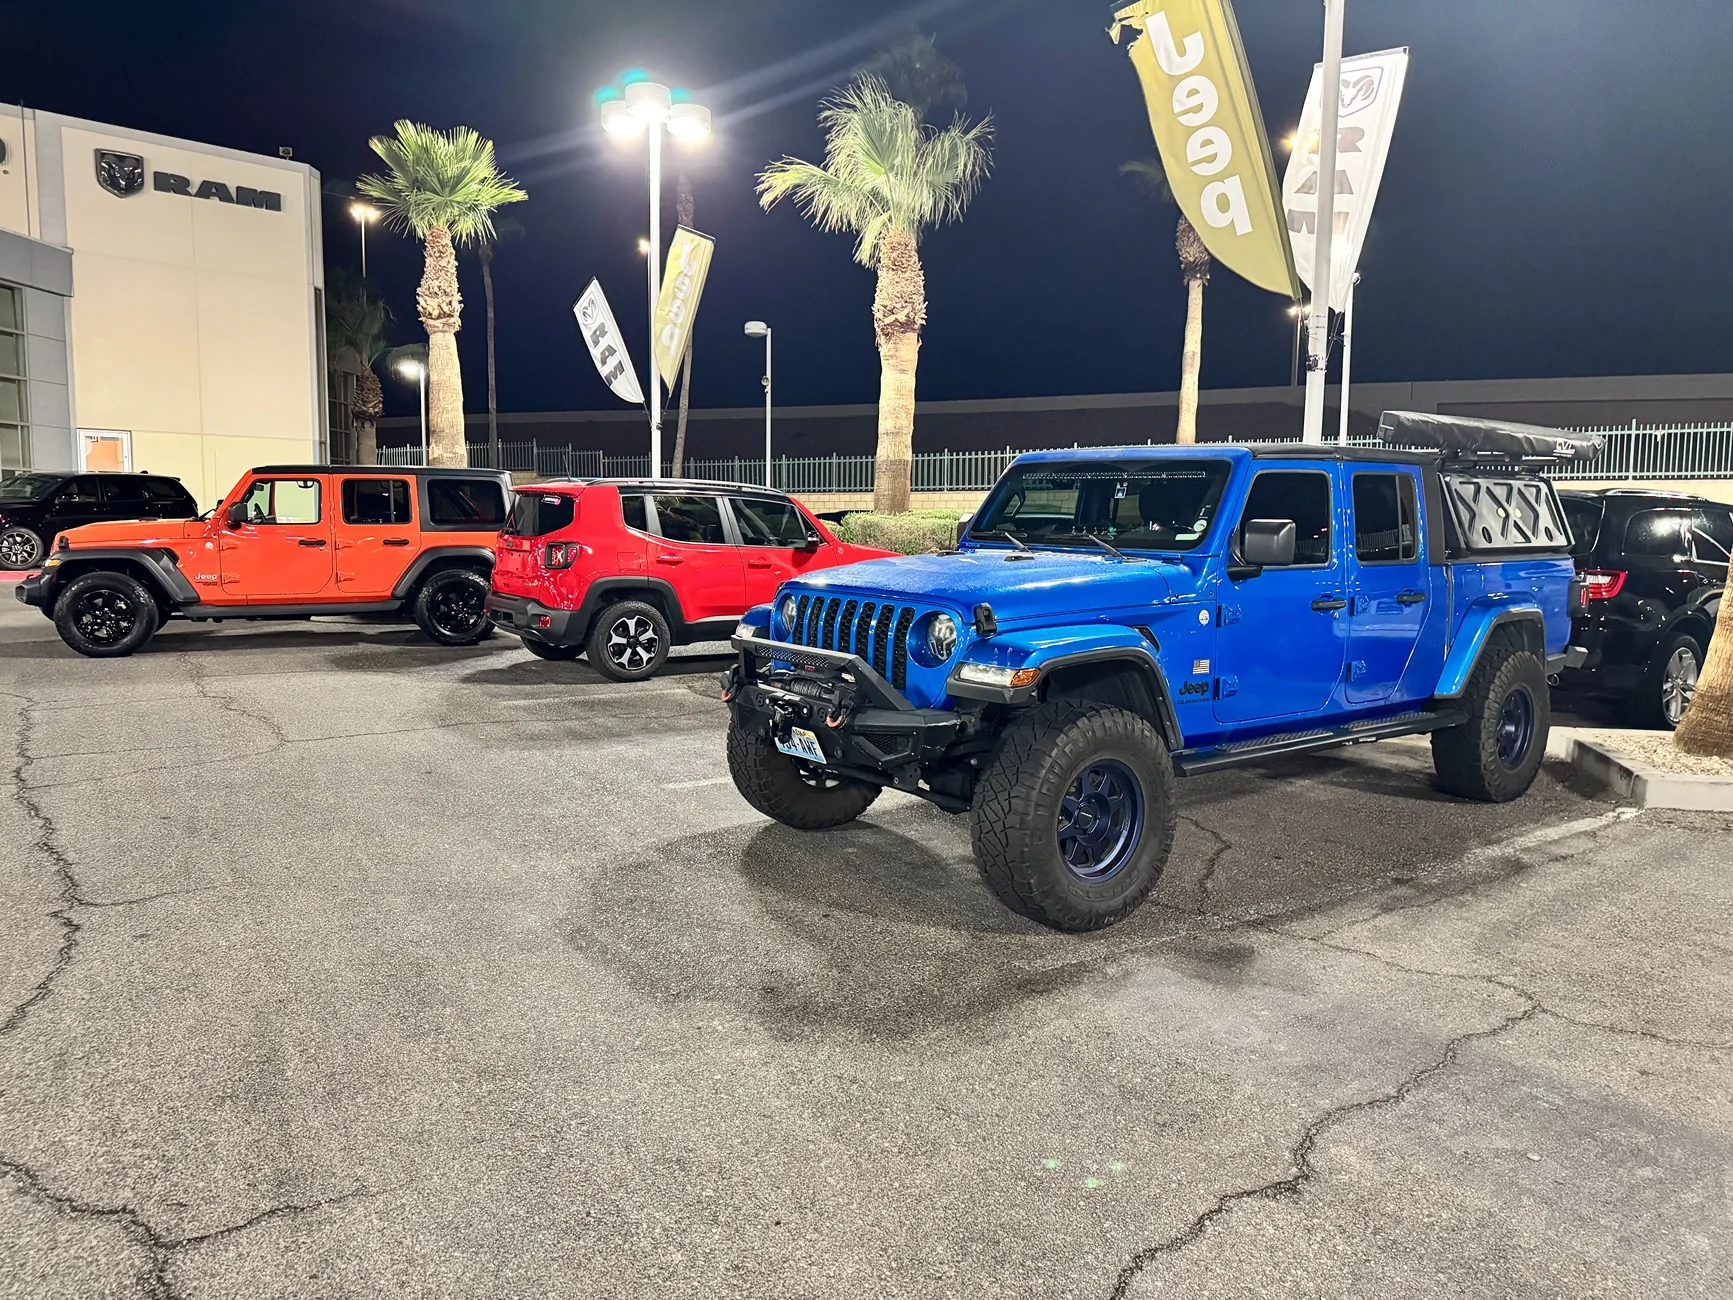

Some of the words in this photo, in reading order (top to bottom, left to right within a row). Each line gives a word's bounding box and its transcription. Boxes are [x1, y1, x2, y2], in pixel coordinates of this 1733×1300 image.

[153, 171, 282, 212] RAM
[590, 322, 625, 387] RAM
[195, 572, 217, 580] Jeep
[1179, 681, 1209, 696] Jeep
